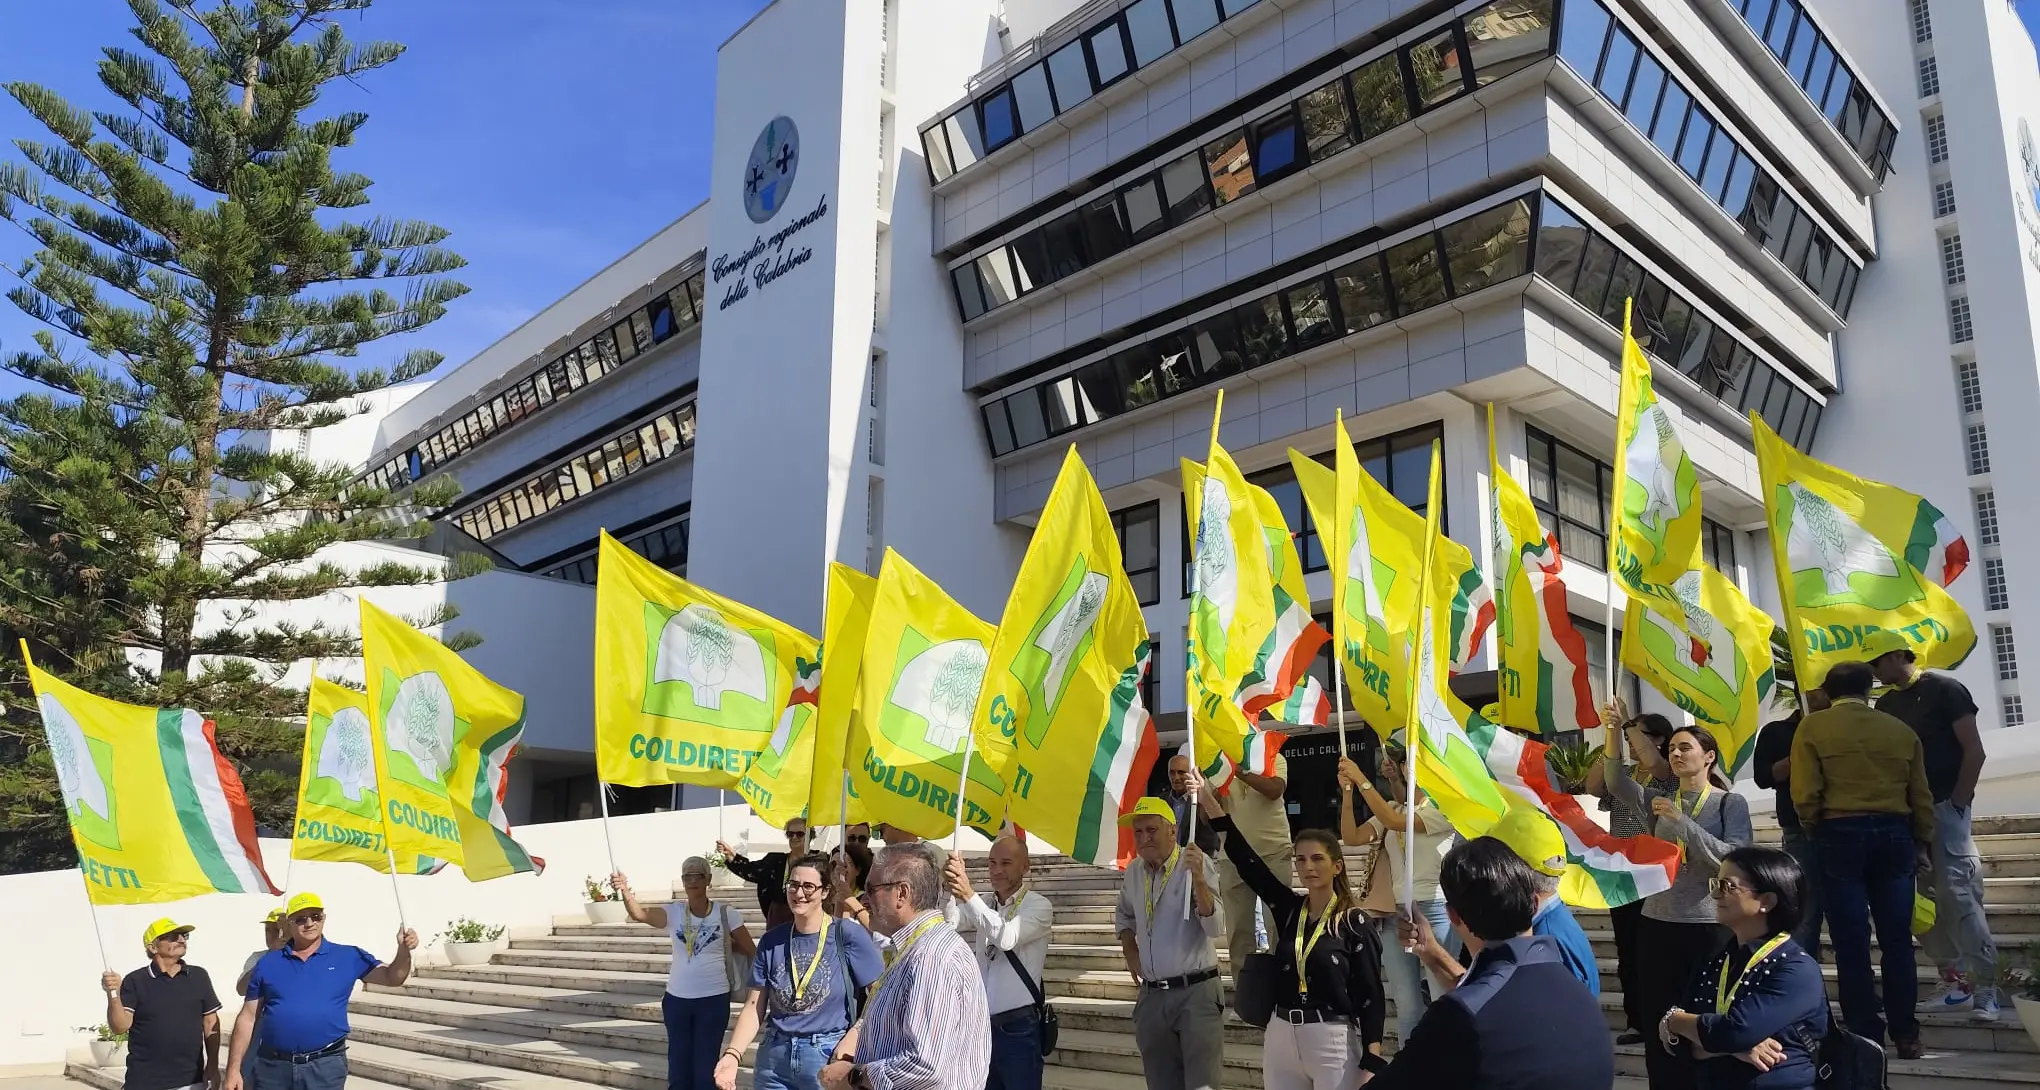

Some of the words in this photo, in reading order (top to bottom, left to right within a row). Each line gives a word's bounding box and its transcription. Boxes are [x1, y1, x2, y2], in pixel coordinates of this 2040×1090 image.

[712, 235, 766, 283] Consiglio
[767, 194, 828, 253] regionale
[719, 277, 749, 311] della
[753, 246, 813, 289] Calabria
[1285, 747, 1315, 758] DELLA
